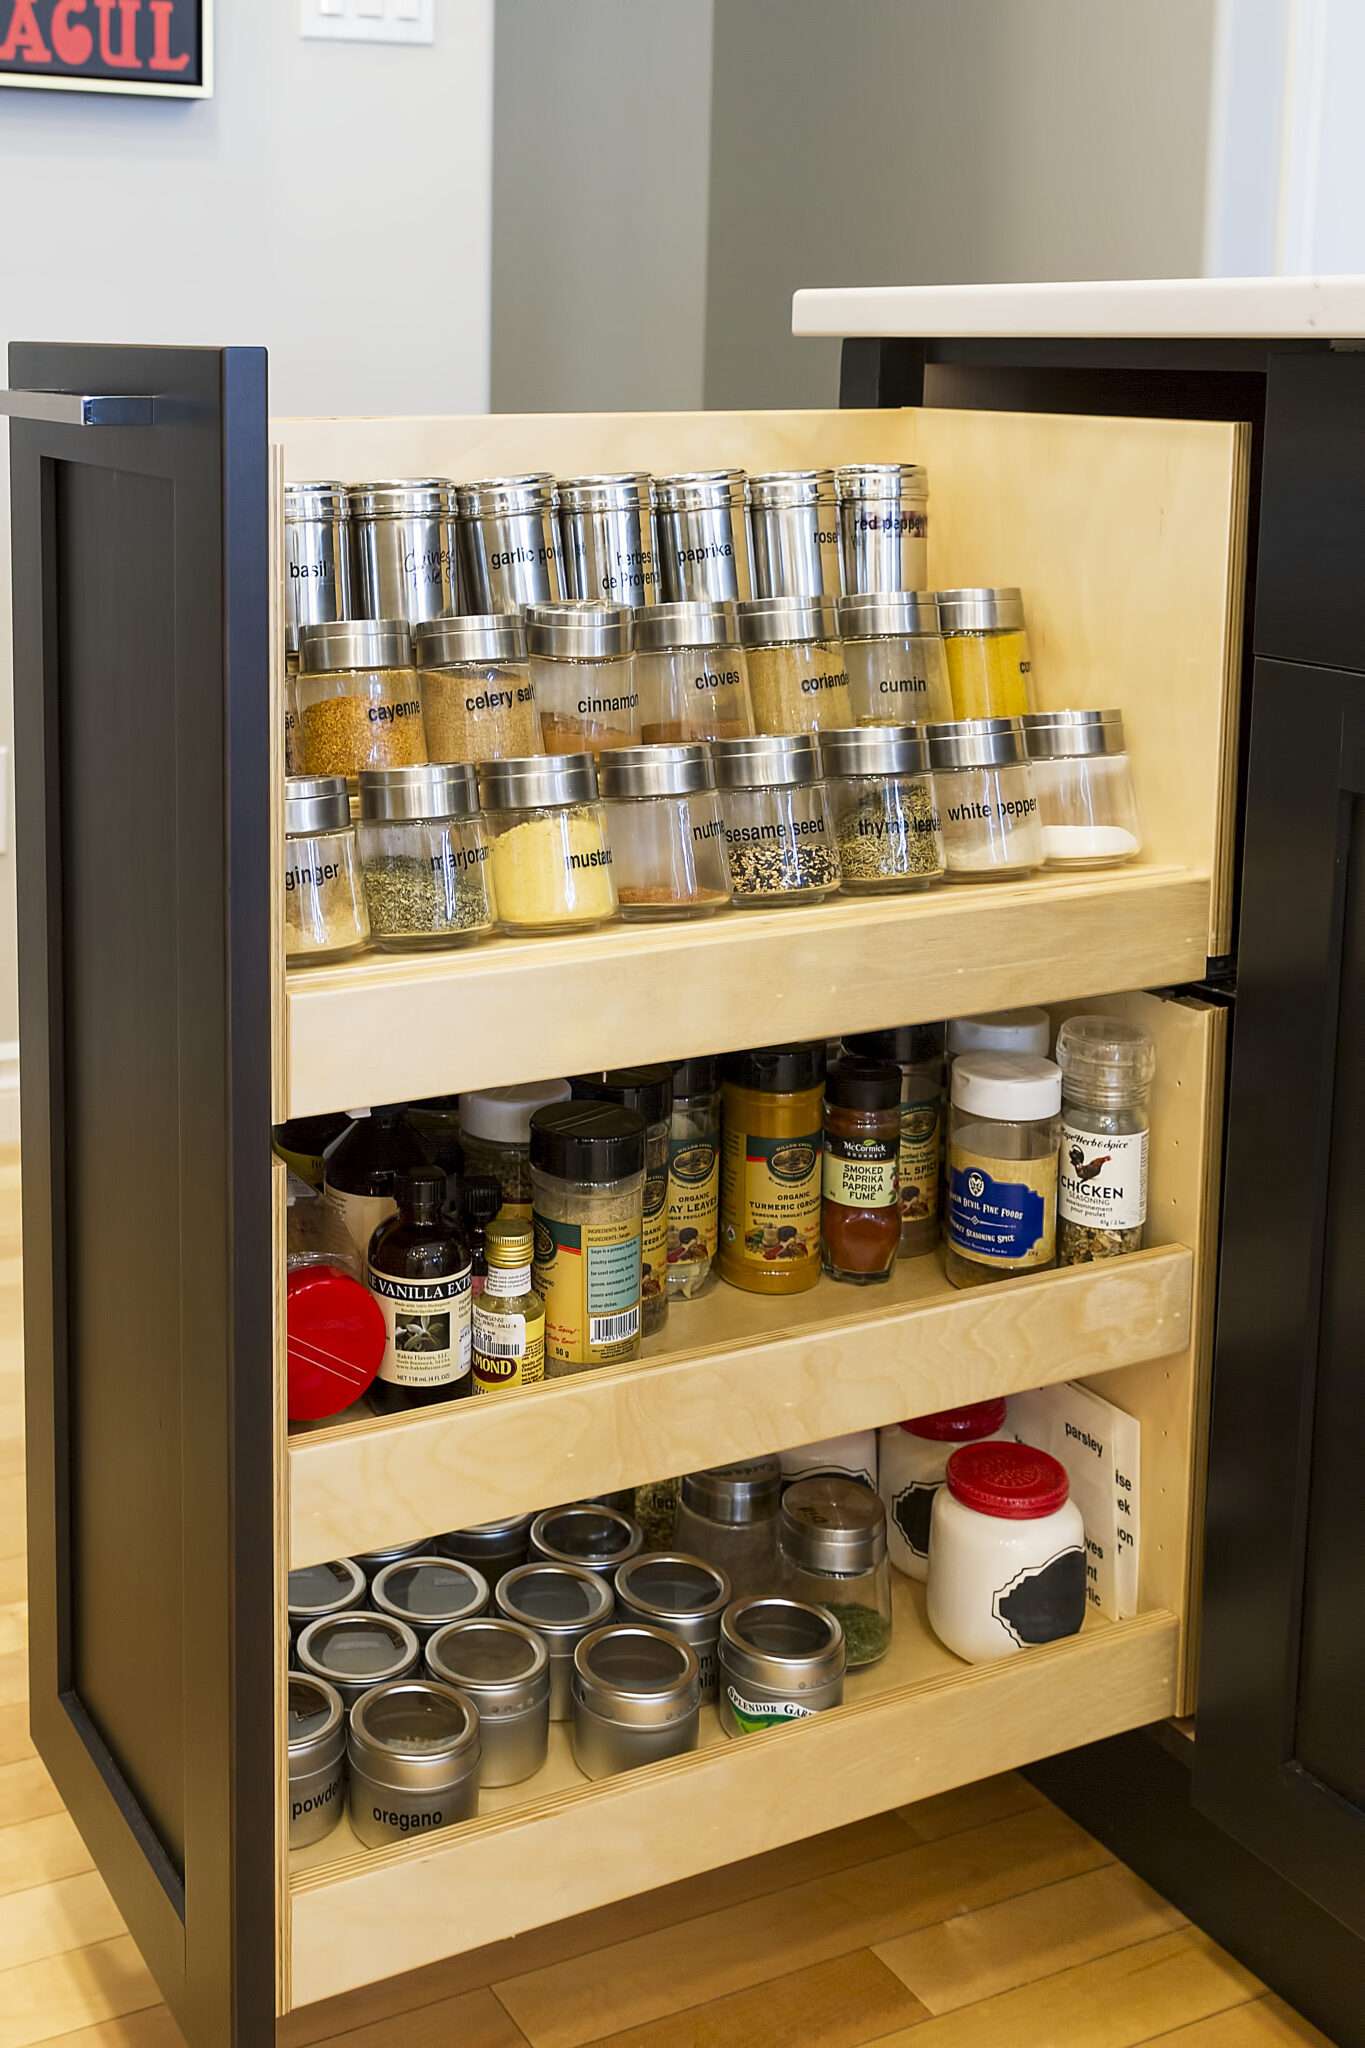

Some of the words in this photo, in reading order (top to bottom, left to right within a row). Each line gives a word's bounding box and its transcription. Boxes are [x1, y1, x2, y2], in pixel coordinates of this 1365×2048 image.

[854, 515, 878, 531] red
[491, 547, 535, 570] garlic
[678, 543, 732, 567] paprika
[290, 560, 327, 578] basil
[602, 573, 618, 590] de
[695, 671, 740, 690] cloves
[879, 676, 927, 694] cumin
[466, 689, 513, 711] celery
[578, 693, 639, 713] cinnamon
[368, 701, 421, 722] cayenne
[948, 803, 991, 821] white
[997, 797, 1037, 817] pepper
[726, 824, 787, 843] sesame
[793, 816, 825, 836] seed
[859, 817, 909, 839] thyme
[285, 863, 340, 891] ginger
[843, 1140, 887, 1153] McCormick
[842, 1173, 884, 1183] PAPRIKA
[844, 1164, 884, 1174] SMOKED
[842, 1181, 884, 1191] PAPRIKA
[1060, 1175, 1124, 1200] CHICKEN
[678, 1192, 709, 1203] ORGANIC
[749, 1200, 795, 1210] TURMERIC
[777, 1191, 811, 1201] ORGANIC
[1069, 1190, 1110, 1206] SEASONING
[669, 1205, 683, 1213] AY
[982, 1203, 999, 1214] FINE
[1001, 1208, 1023, 1220] FOODS
[379, 1279, 445, 1300] VANILLA
[1065, 1421, 1104, 1458] parsley
[728, 1687, 778, 1713] SPLENDOR
[372, 1807, 443, 1831] oregano
